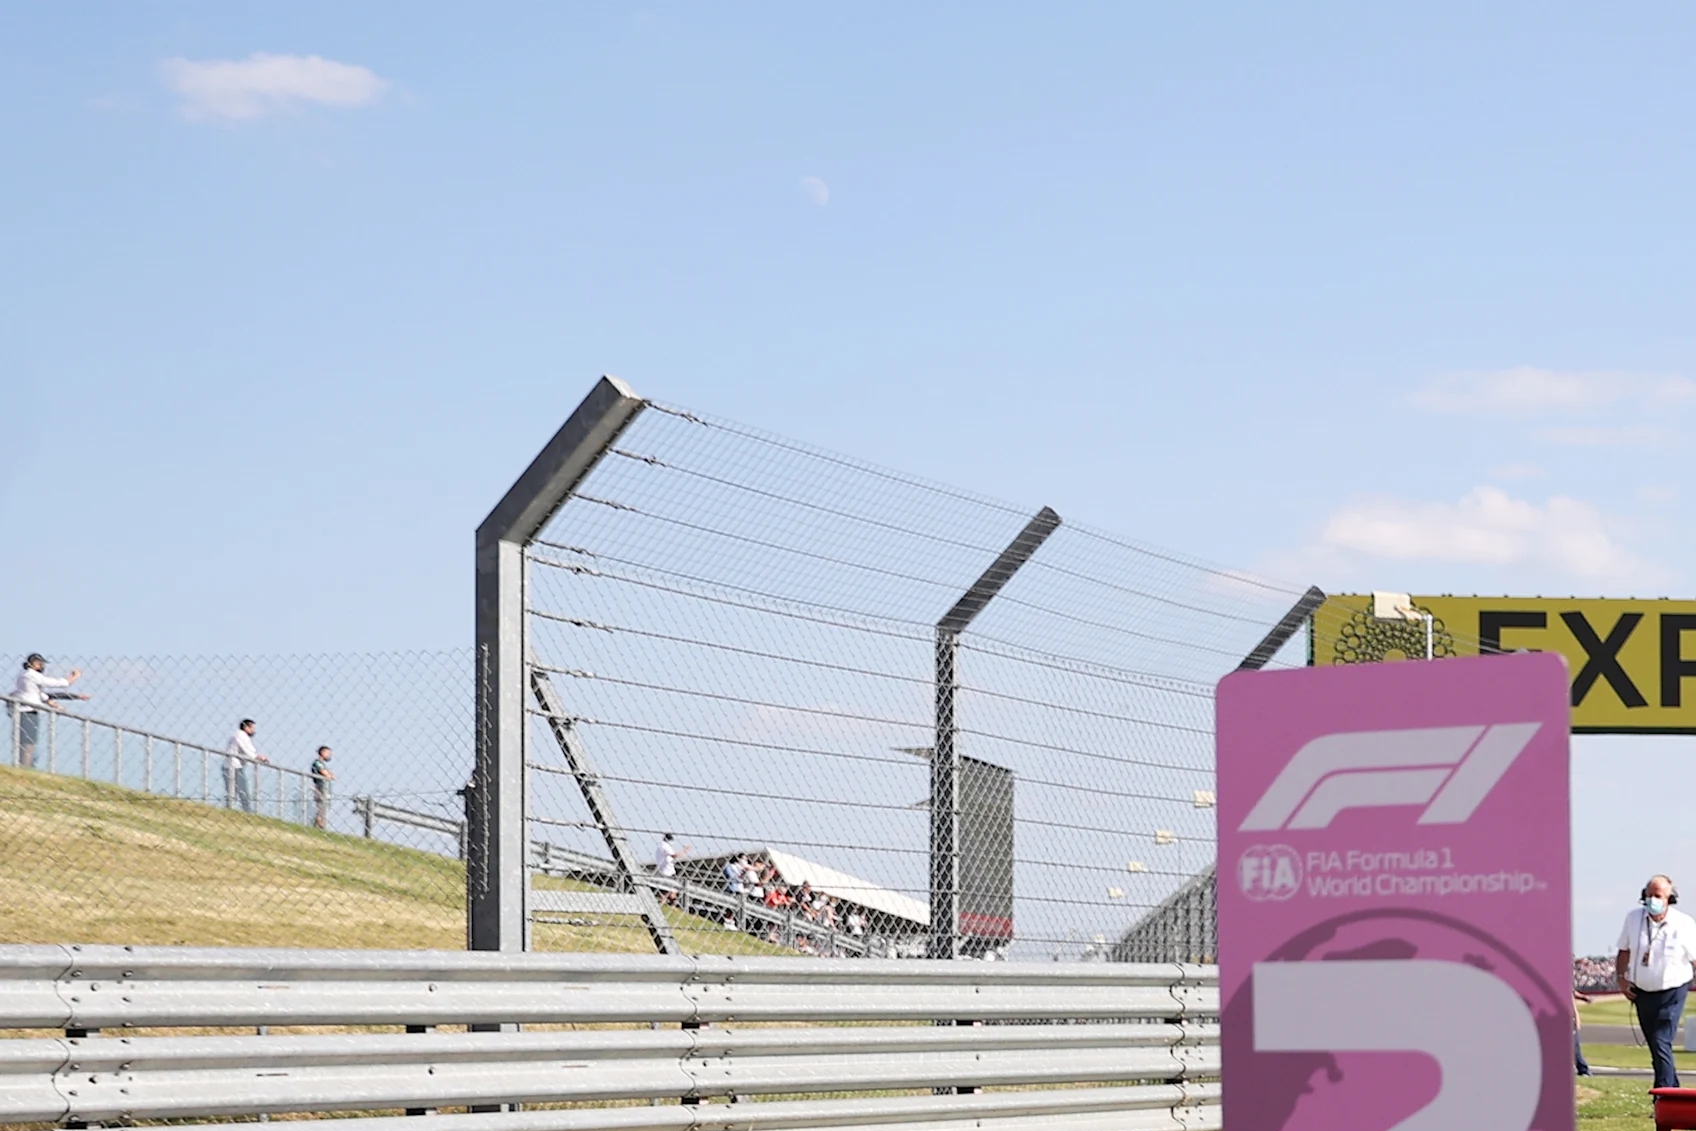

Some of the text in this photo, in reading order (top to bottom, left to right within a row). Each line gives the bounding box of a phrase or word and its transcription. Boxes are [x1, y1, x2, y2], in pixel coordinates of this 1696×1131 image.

[1307, 847, 1456, 872] FIA Formula 1
[1240, 854, 1297, 892] FIA
[1306, 874, 1372, 897] World
